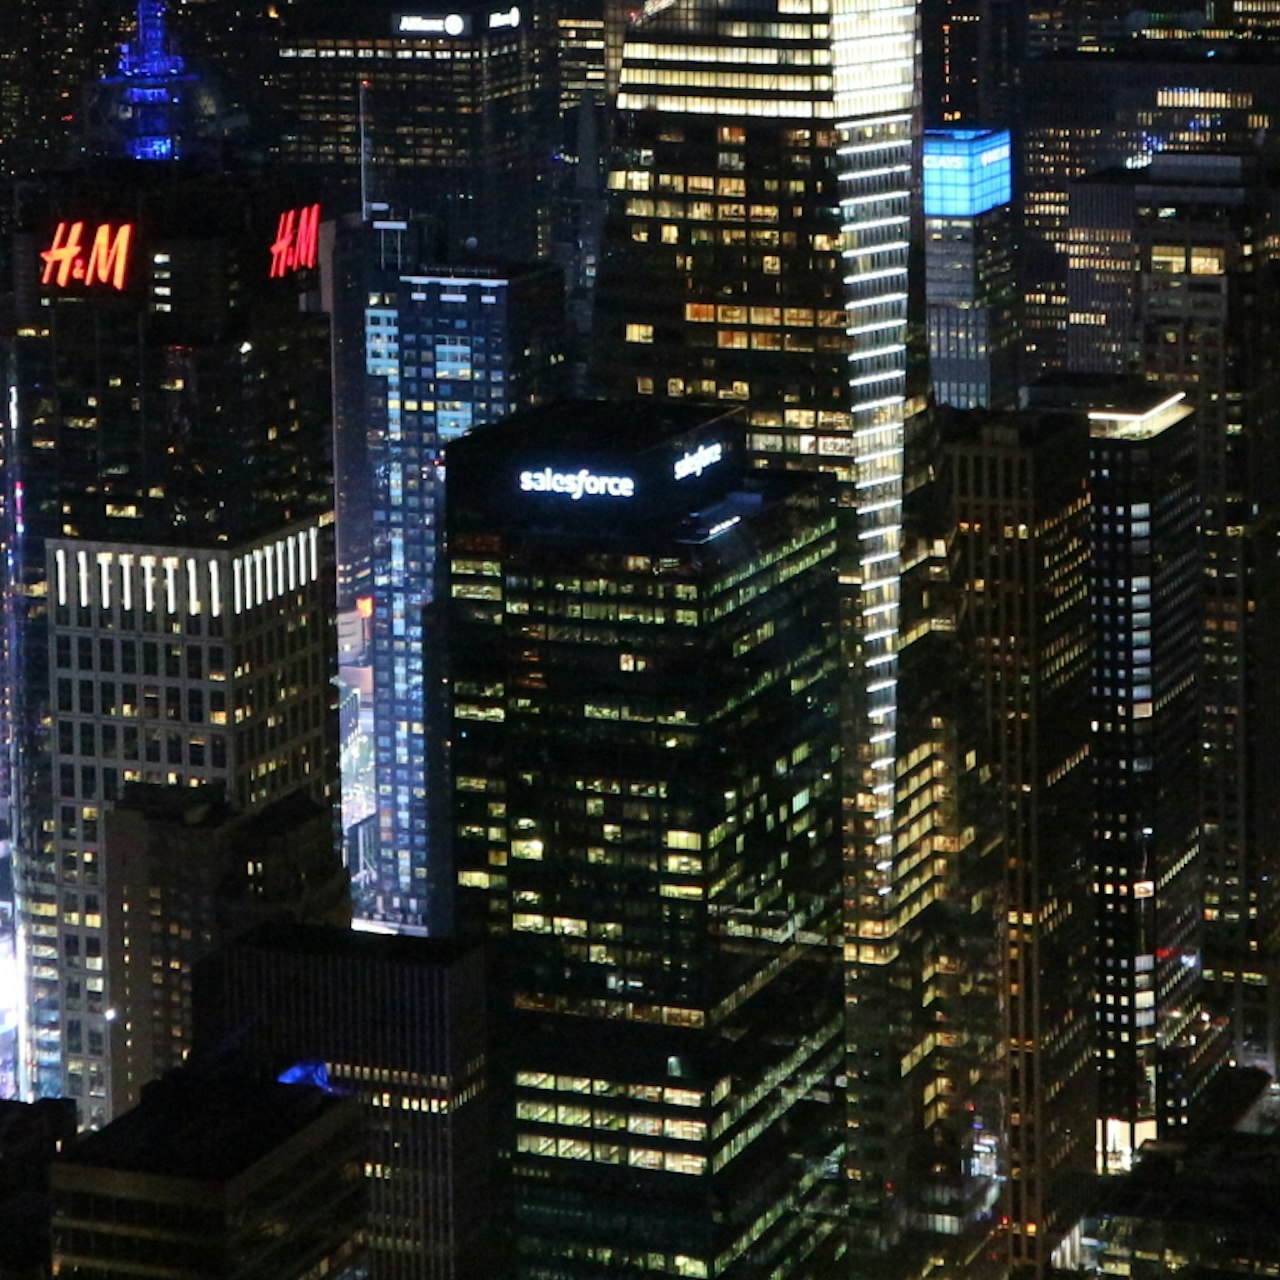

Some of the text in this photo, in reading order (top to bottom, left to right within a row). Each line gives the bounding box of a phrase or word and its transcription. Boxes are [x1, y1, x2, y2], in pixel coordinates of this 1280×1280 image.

[40, 221, 132, 290] H&M
[270, 203, 320, 278] H&M
[520, 467, 635, 500] salesforce
